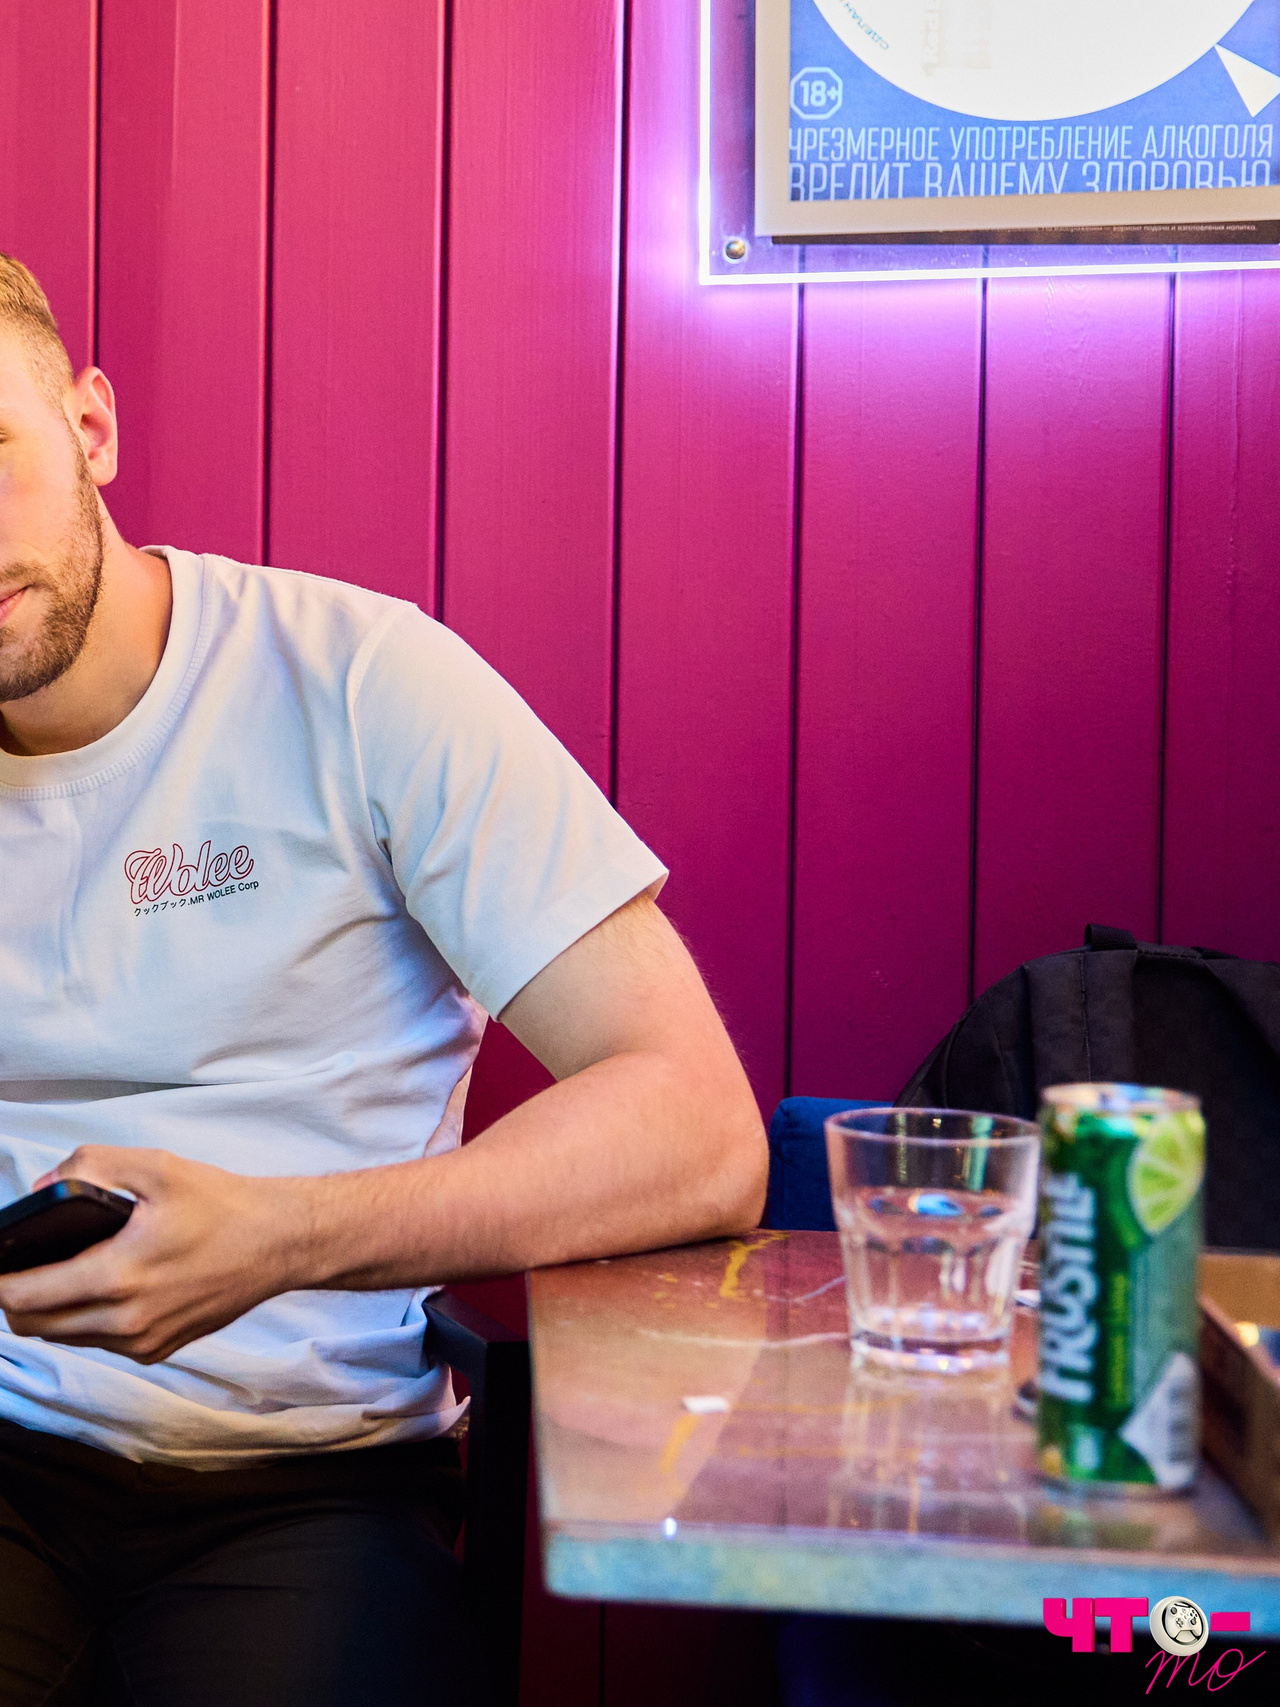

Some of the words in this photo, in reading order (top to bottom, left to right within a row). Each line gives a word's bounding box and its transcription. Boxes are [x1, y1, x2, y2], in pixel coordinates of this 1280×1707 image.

[800, 80, 840, 107] 18+
[789, 127, 939, 161] ЧРЕЗМЕРНОЕ
[950, 126, 1133, 160] УПОТРЕБЛЕНИЕ
[1142, 124, 1273, 159] АЛКОГОЛЯ
[789, 162, 911, 200] ВРЕДИТ
[925, 162, 1068, 198] ВАШЕМУ
[124, 840, 255, 904] Wolee
[206, 886, 236, 901] WOLEE
[238, 880, 260, 892] Corp
